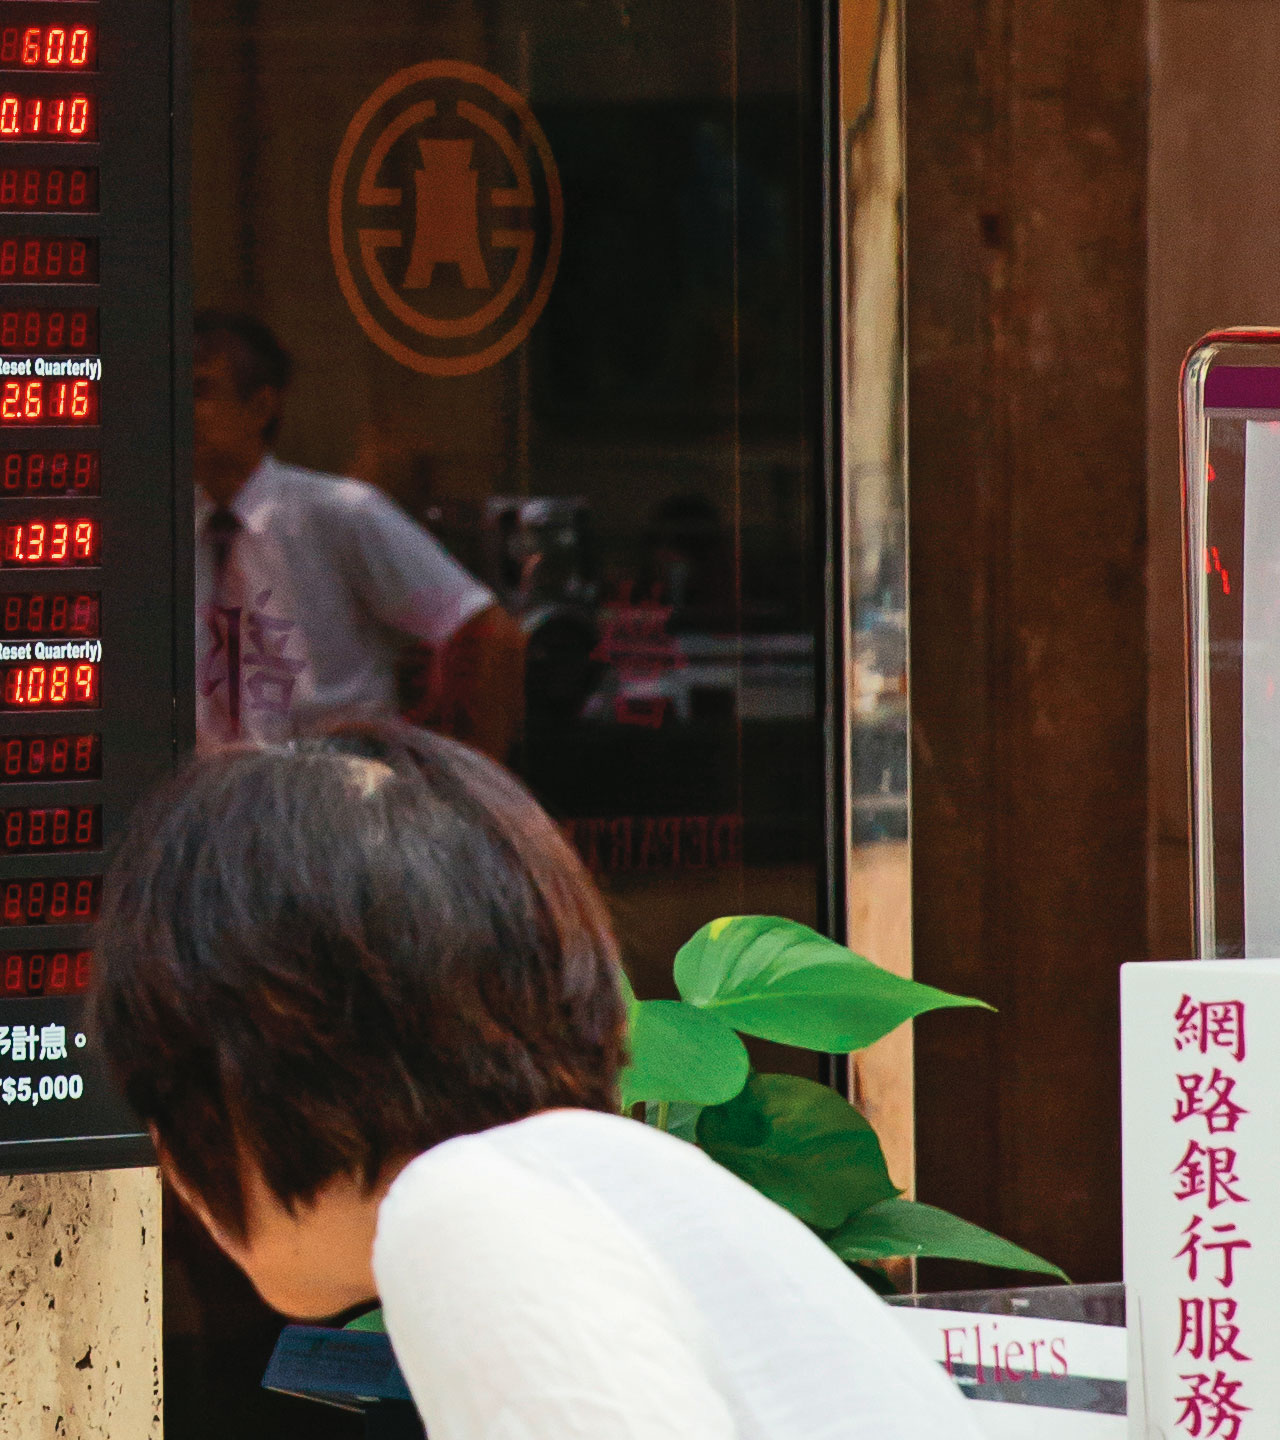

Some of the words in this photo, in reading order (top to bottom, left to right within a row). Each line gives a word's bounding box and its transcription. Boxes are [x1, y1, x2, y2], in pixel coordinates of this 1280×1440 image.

[0, 99, 87, 133] 0.110
[2, 382, 88, 417] 2.616
[16, 666, 92, 702] 1.089
[940, 1322, 1068, 1384] Fliers
